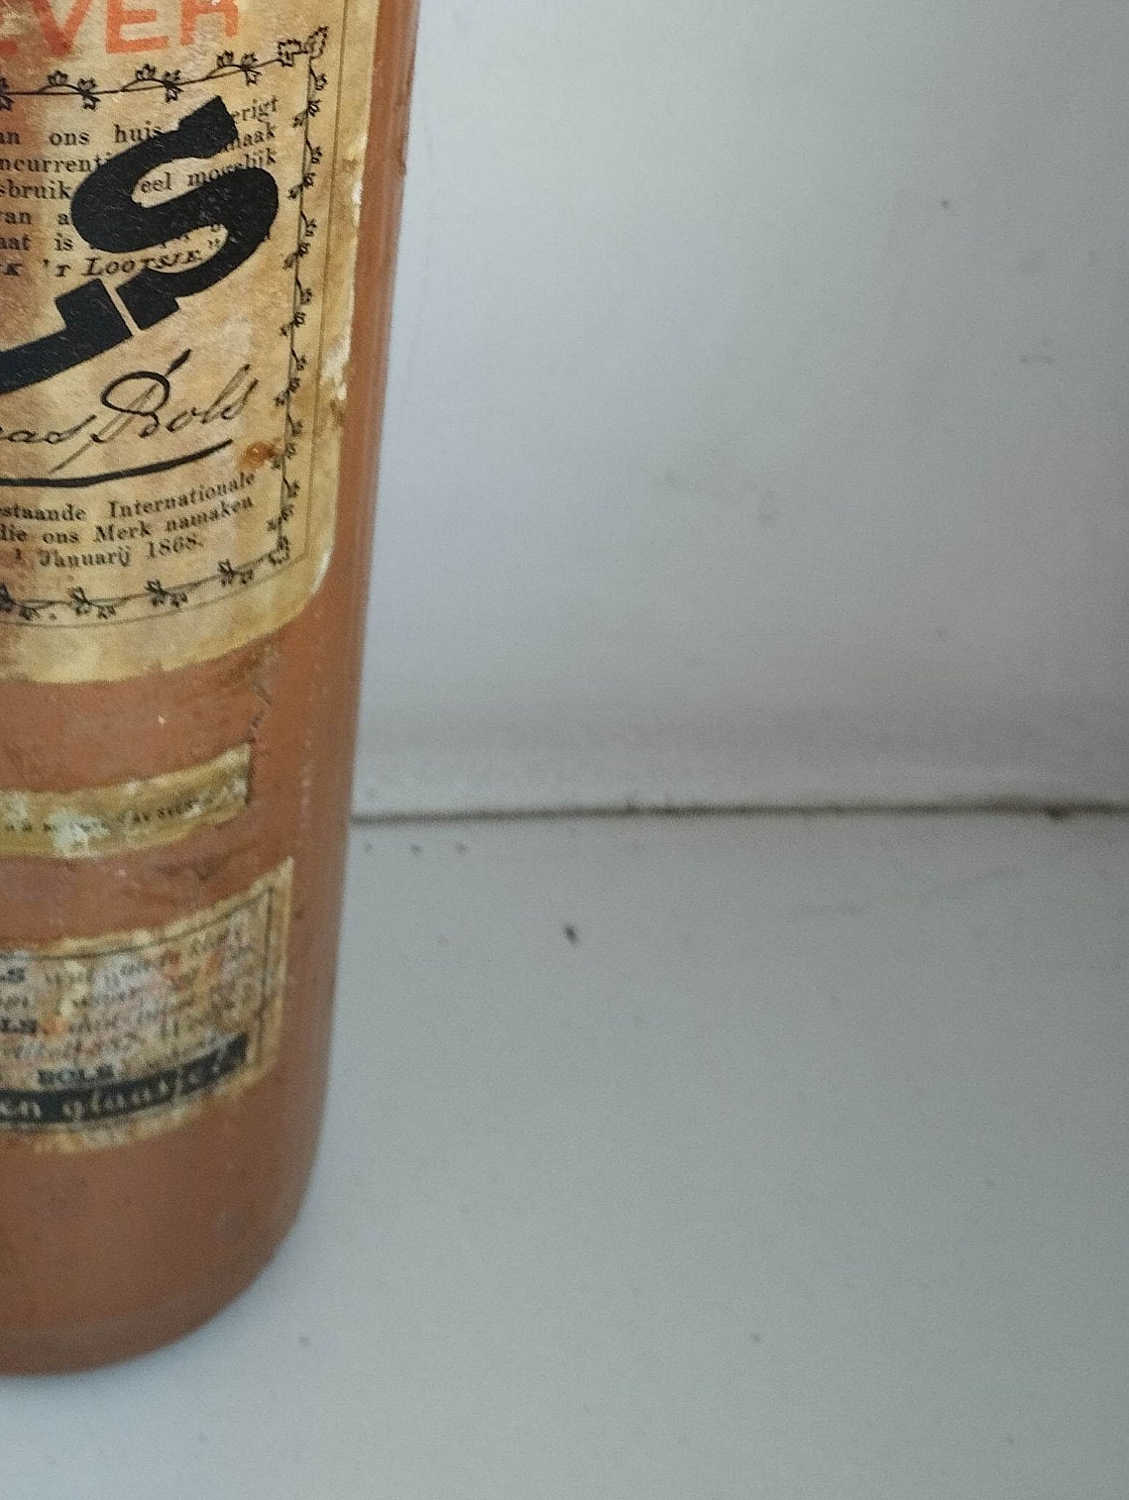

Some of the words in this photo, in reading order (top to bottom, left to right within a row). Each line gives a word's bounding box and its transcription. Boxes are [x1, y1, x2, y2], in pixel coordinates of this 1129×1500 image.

[49, 130, 90, 147] ons
[54, 232, 74, 251] is
[109, 470, 256, 520] Internationale
[42, 527, 80, 545] ons
[95, 521, 152, 543] Merk
[166, 494, 254, 531] namaken
